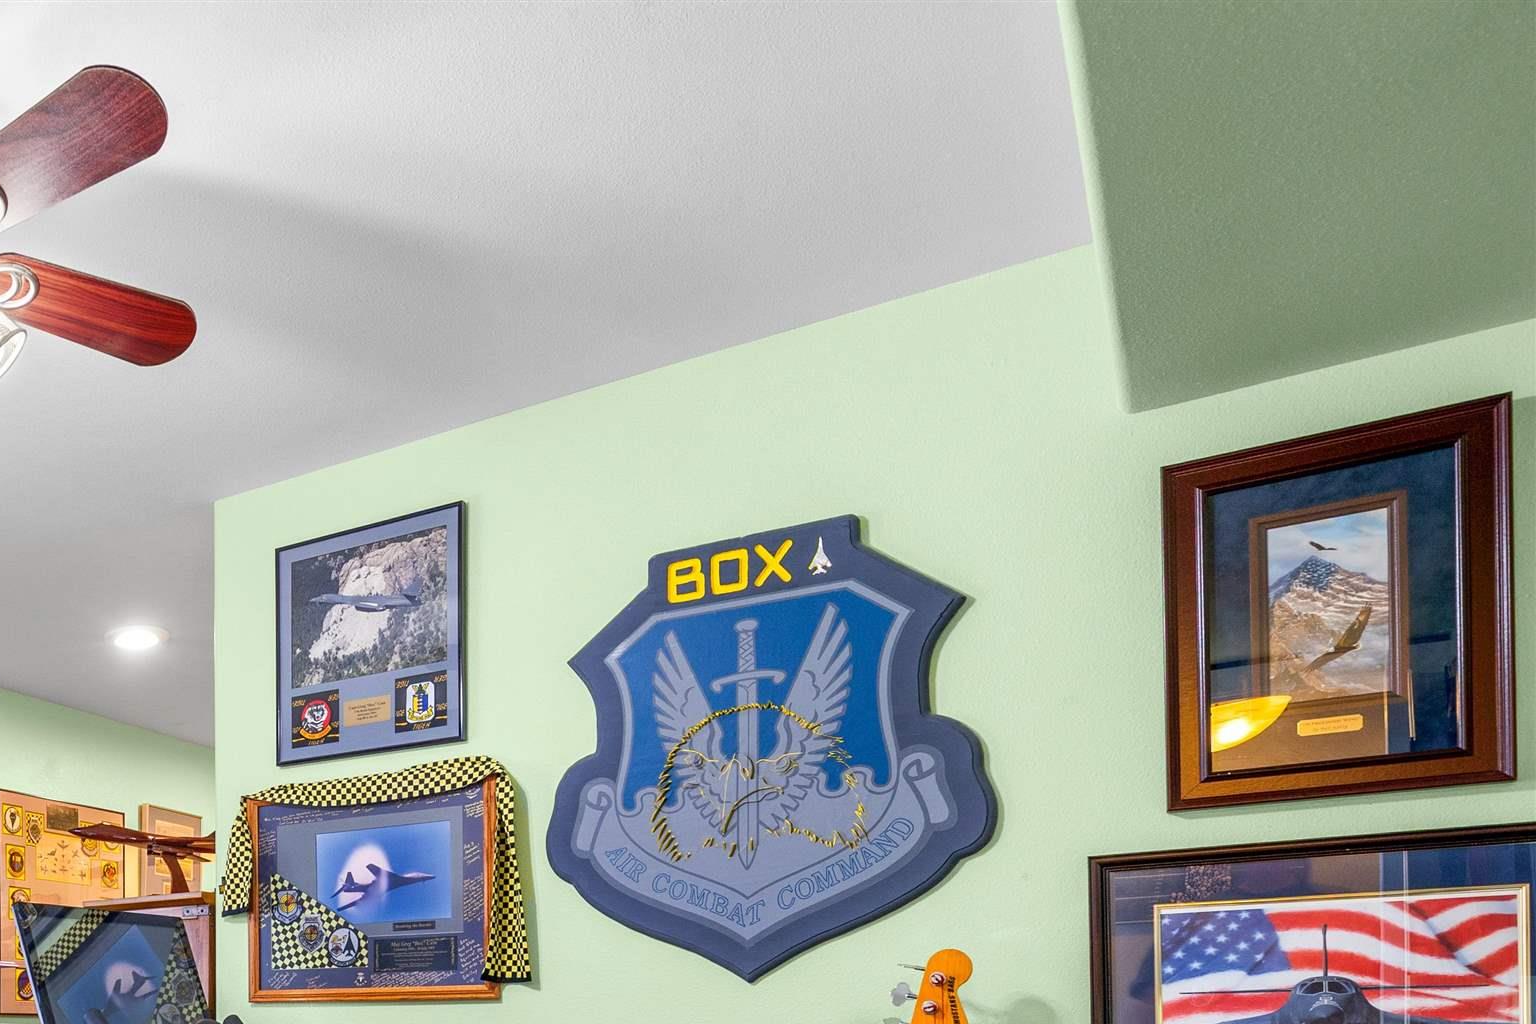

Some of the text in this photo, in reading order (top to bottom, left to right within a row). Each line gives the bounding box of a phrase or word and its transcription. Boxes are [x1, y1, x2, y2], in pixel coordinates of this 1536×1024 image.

[667, 540, 793, 604] BOX
[605, 816, 915, 928] AIR COMBAT COMMAND
